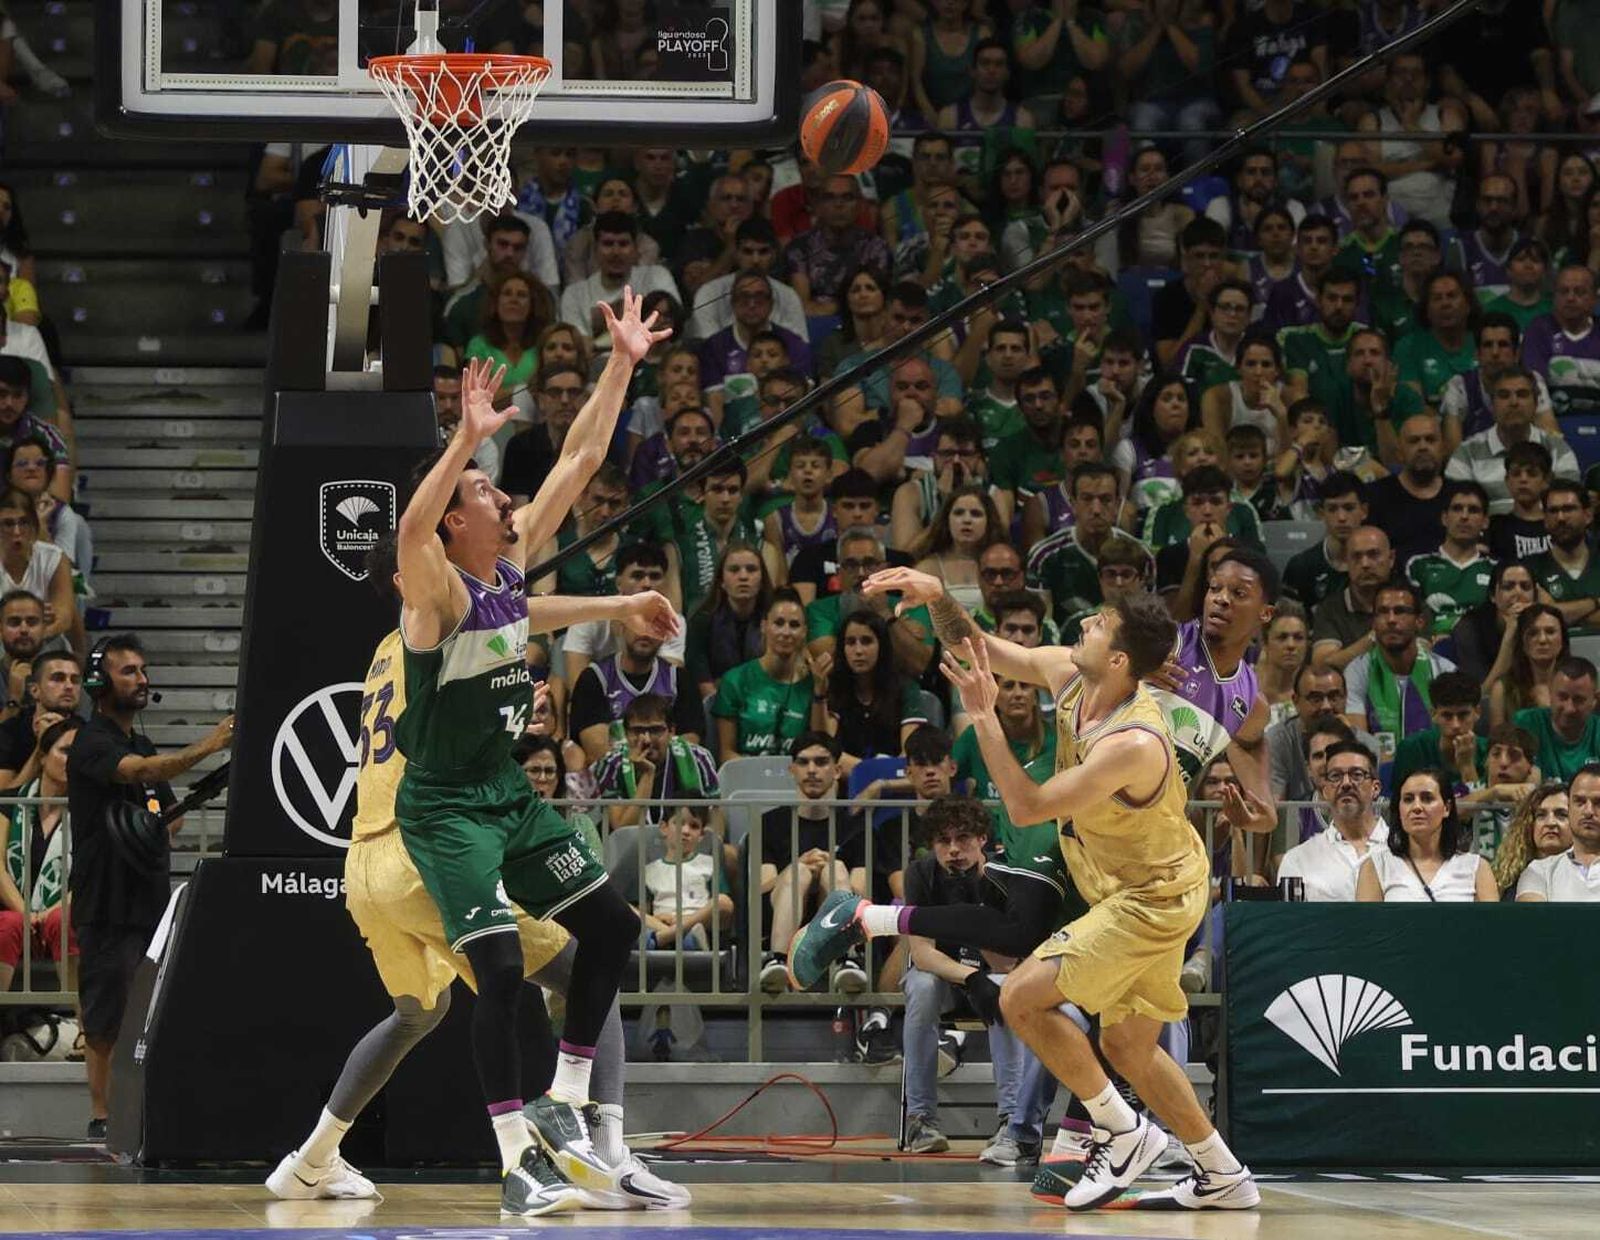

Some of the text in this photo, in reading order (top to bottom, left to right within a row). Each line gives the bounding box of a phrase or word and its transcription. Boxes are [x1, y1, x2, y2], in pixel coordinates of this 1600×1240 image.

[658, 40, 720, 52] PLAYOFF
[337, 529, 379, 542] Unicaja
[1515, 534, 1553, 559] EVERLA
[499, 704, 528, 740] 14
[1401, 1034, 1597, 1071] Fundaci
